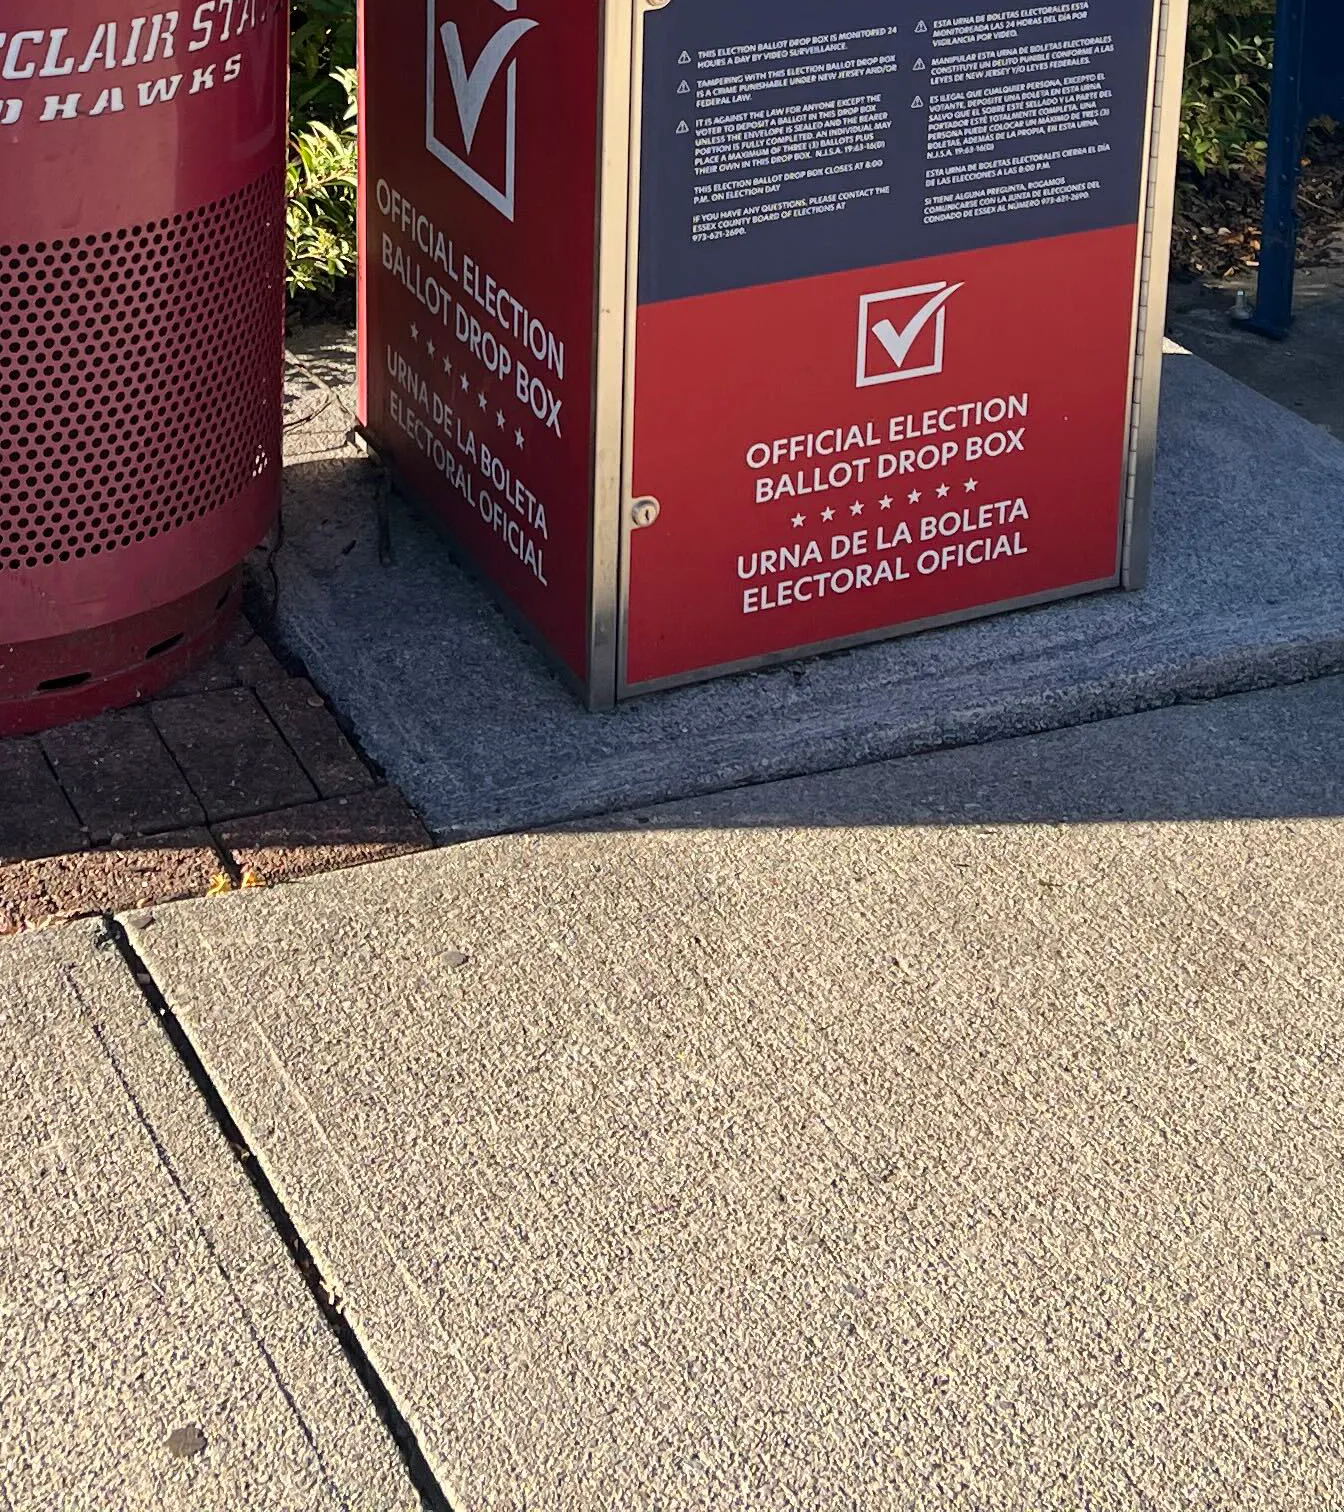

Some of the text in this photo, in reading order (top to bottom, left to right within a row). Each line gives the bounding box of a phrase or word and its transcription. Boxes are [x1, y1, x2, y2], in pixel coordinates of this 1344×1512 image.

[376, 178, 565, 380] OFFICIAL ELECTION
[382, 232, 563, 439] BALLOT DROP BOX
[387, 343, 548, 541] URNA DE LA BOLETA
[389, 388, 548, 587] ELECTORAL OFICIAL
[746, 393, 1029, 470] OFFICIAL ELECTION
[756, 427, 1026, 504] BALLOT DROP BOX
[736, 497, 1030, 580] URNA DE LA BOLETA
[742, 532, 1028, 614] ELECTORAL OFICIAL
